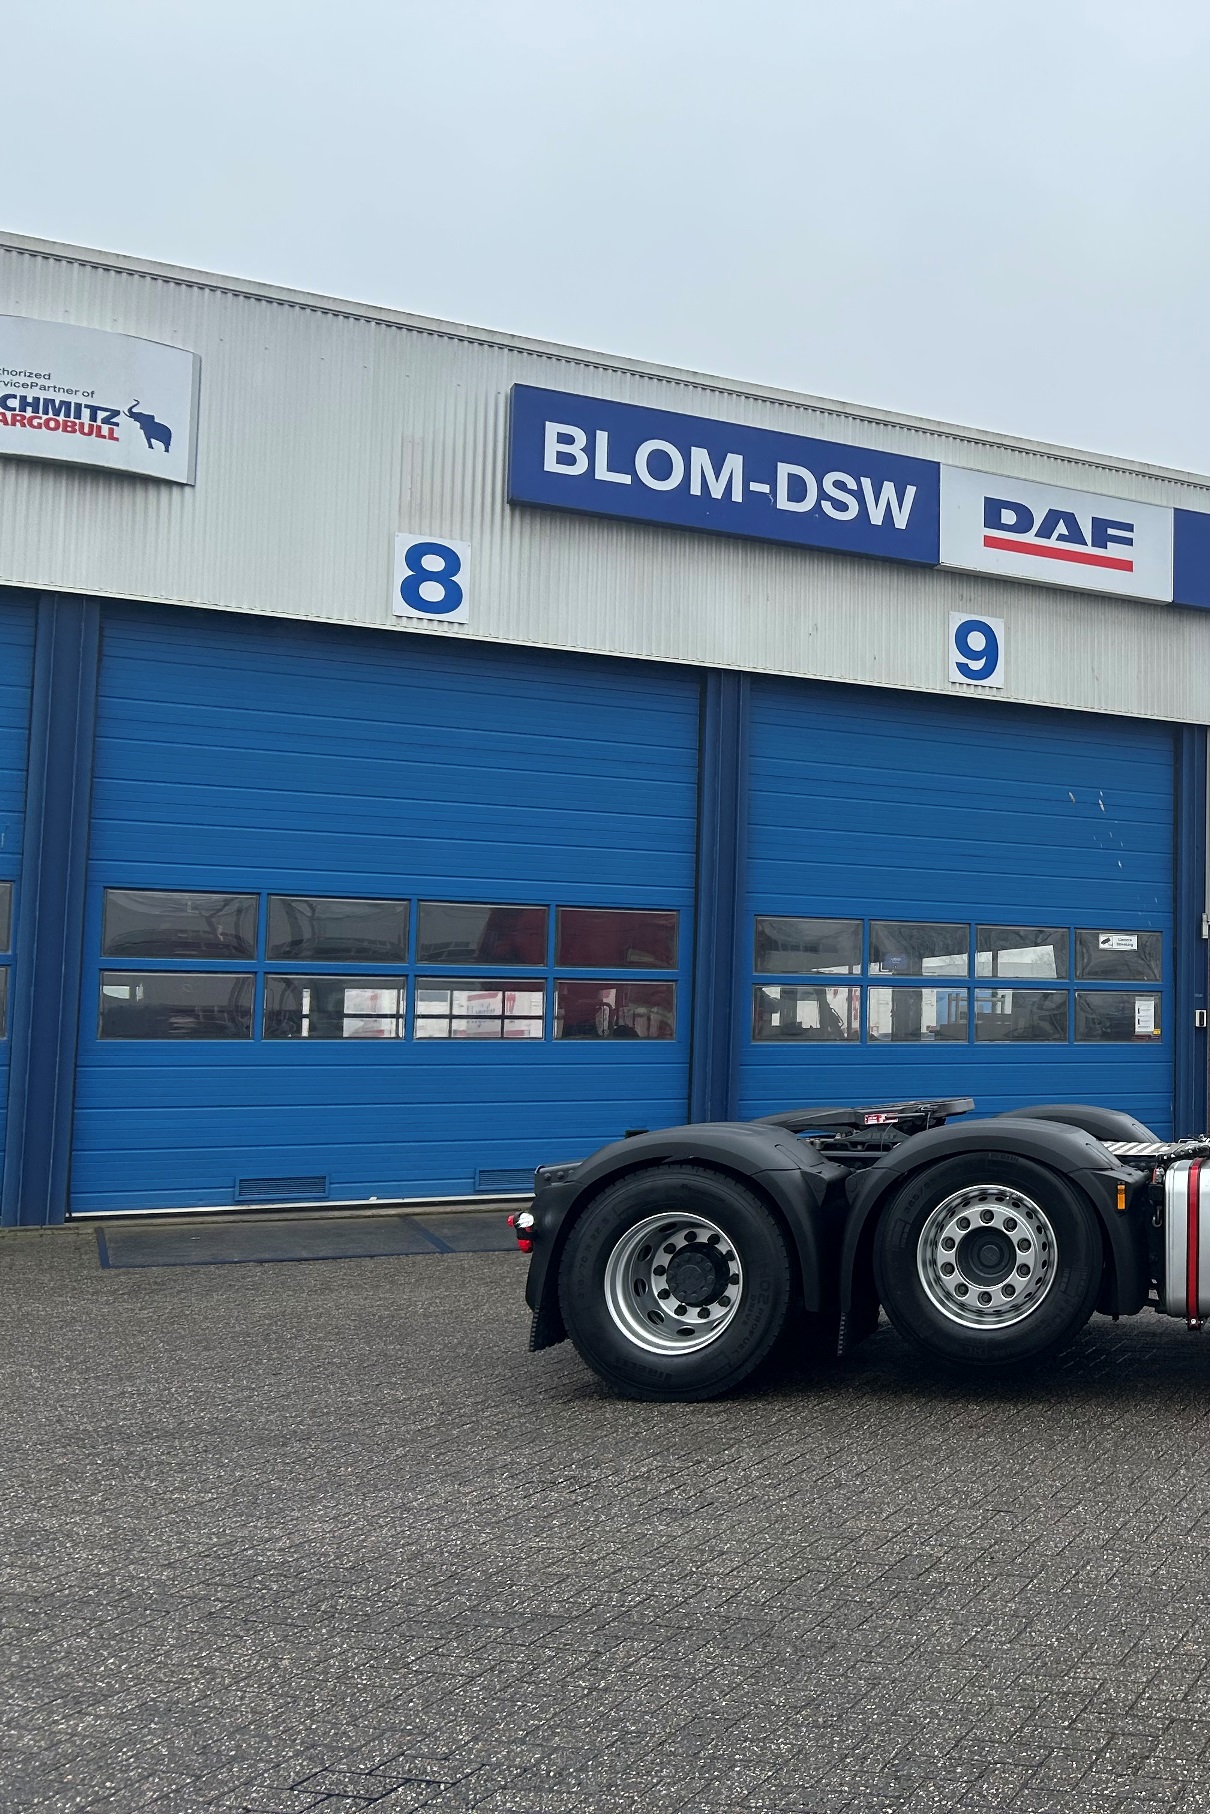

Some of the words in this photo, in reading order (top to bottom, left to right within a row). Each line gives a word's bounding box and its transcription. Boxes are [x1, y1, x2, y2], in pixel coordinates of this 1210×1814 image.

[82, 390, 95, 398] of
[0, 412, 119, 442] ARGOBULL
[544, 421, 917, 530] BLOM-DSW
[984, 496, 1135, 550] DAF
[400, 542, 463, 615] 8
[954, 619, 999, 681] 9
